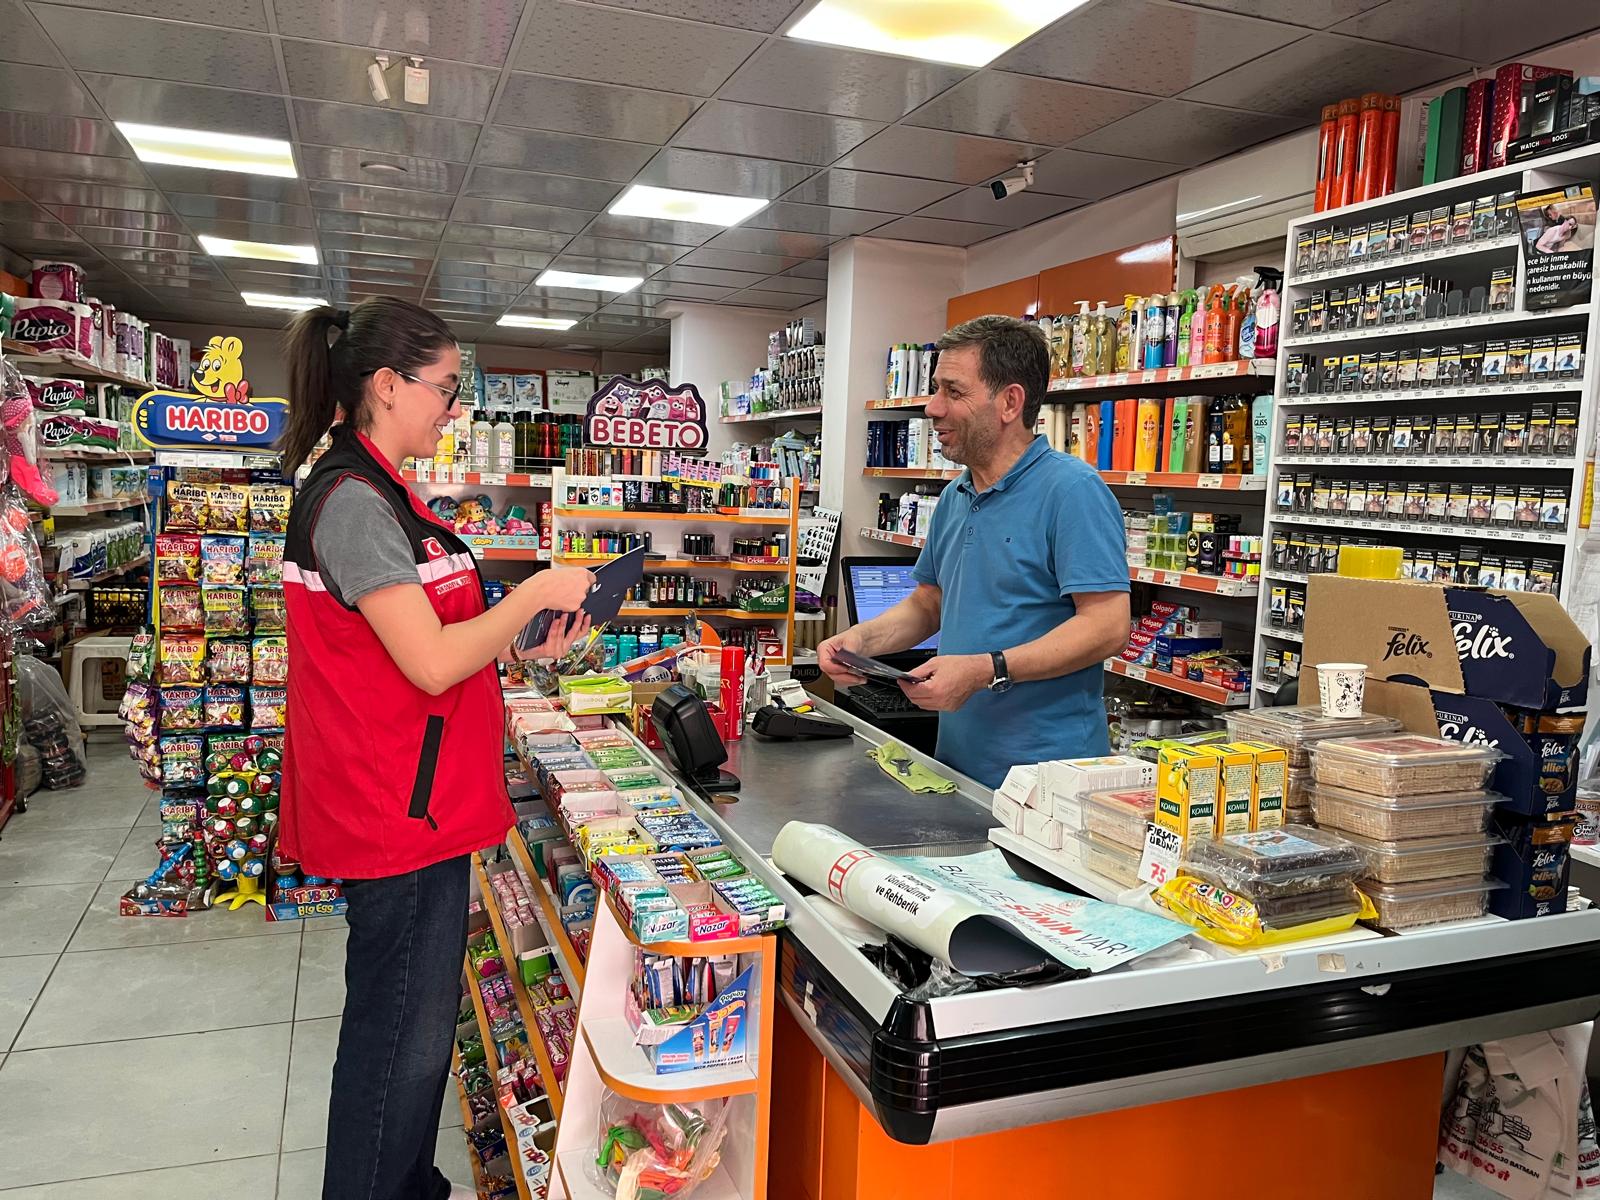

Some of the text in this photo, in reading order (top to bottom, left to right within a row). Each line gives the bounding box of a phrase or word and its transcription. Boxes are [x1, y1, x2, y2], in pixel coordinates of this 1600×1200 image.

[1550, 254, 1569, 262] inme
[1550, 260, 1588, 271] bırakabilir
[1532, 275, 1561, 284] kullanımı
[1529, 283, 1560, 293] nedenidir.
[12, 319, 69, 341] Papia
[43, 387, 74, 405] Papia
[167, 405, 268, 433] HARIBO
[43, 421, 74, 440] Papia
[593, 418, 701, 448] BEBETO
[210, 491, 245, 500] HARIBO
[252, 495, 286, 503] HARIBO
[160, 543, 195, 551] HARIBO
[206, 546, 240, 554] HARIBO
[256, 590, 285, 599] HARIB
[1151, 603, 1175, 614] Colgate
[1141, 617, 1163, 628] Colgate
[1130, 632, 1152, 643] Colgate
[1383, 632, 1429, 661] felix
[793, 668, 819, 678] DURU
[163, 743, 197, 752] HARIBO
[1541, 742, 1566, 758] felix
[1532, 853, 1556, 868] felix
[1151, 863, 1167, 884] 75
[875, 884, 920, 916] ve Rehberlik
[699, 919, 729, 934] Nazar
[1074, 933, 1139, 957] VAR!
[1491, 1142, 1504, 1154] 55
[1509, 1160, 1540, 1179] BATMAN
